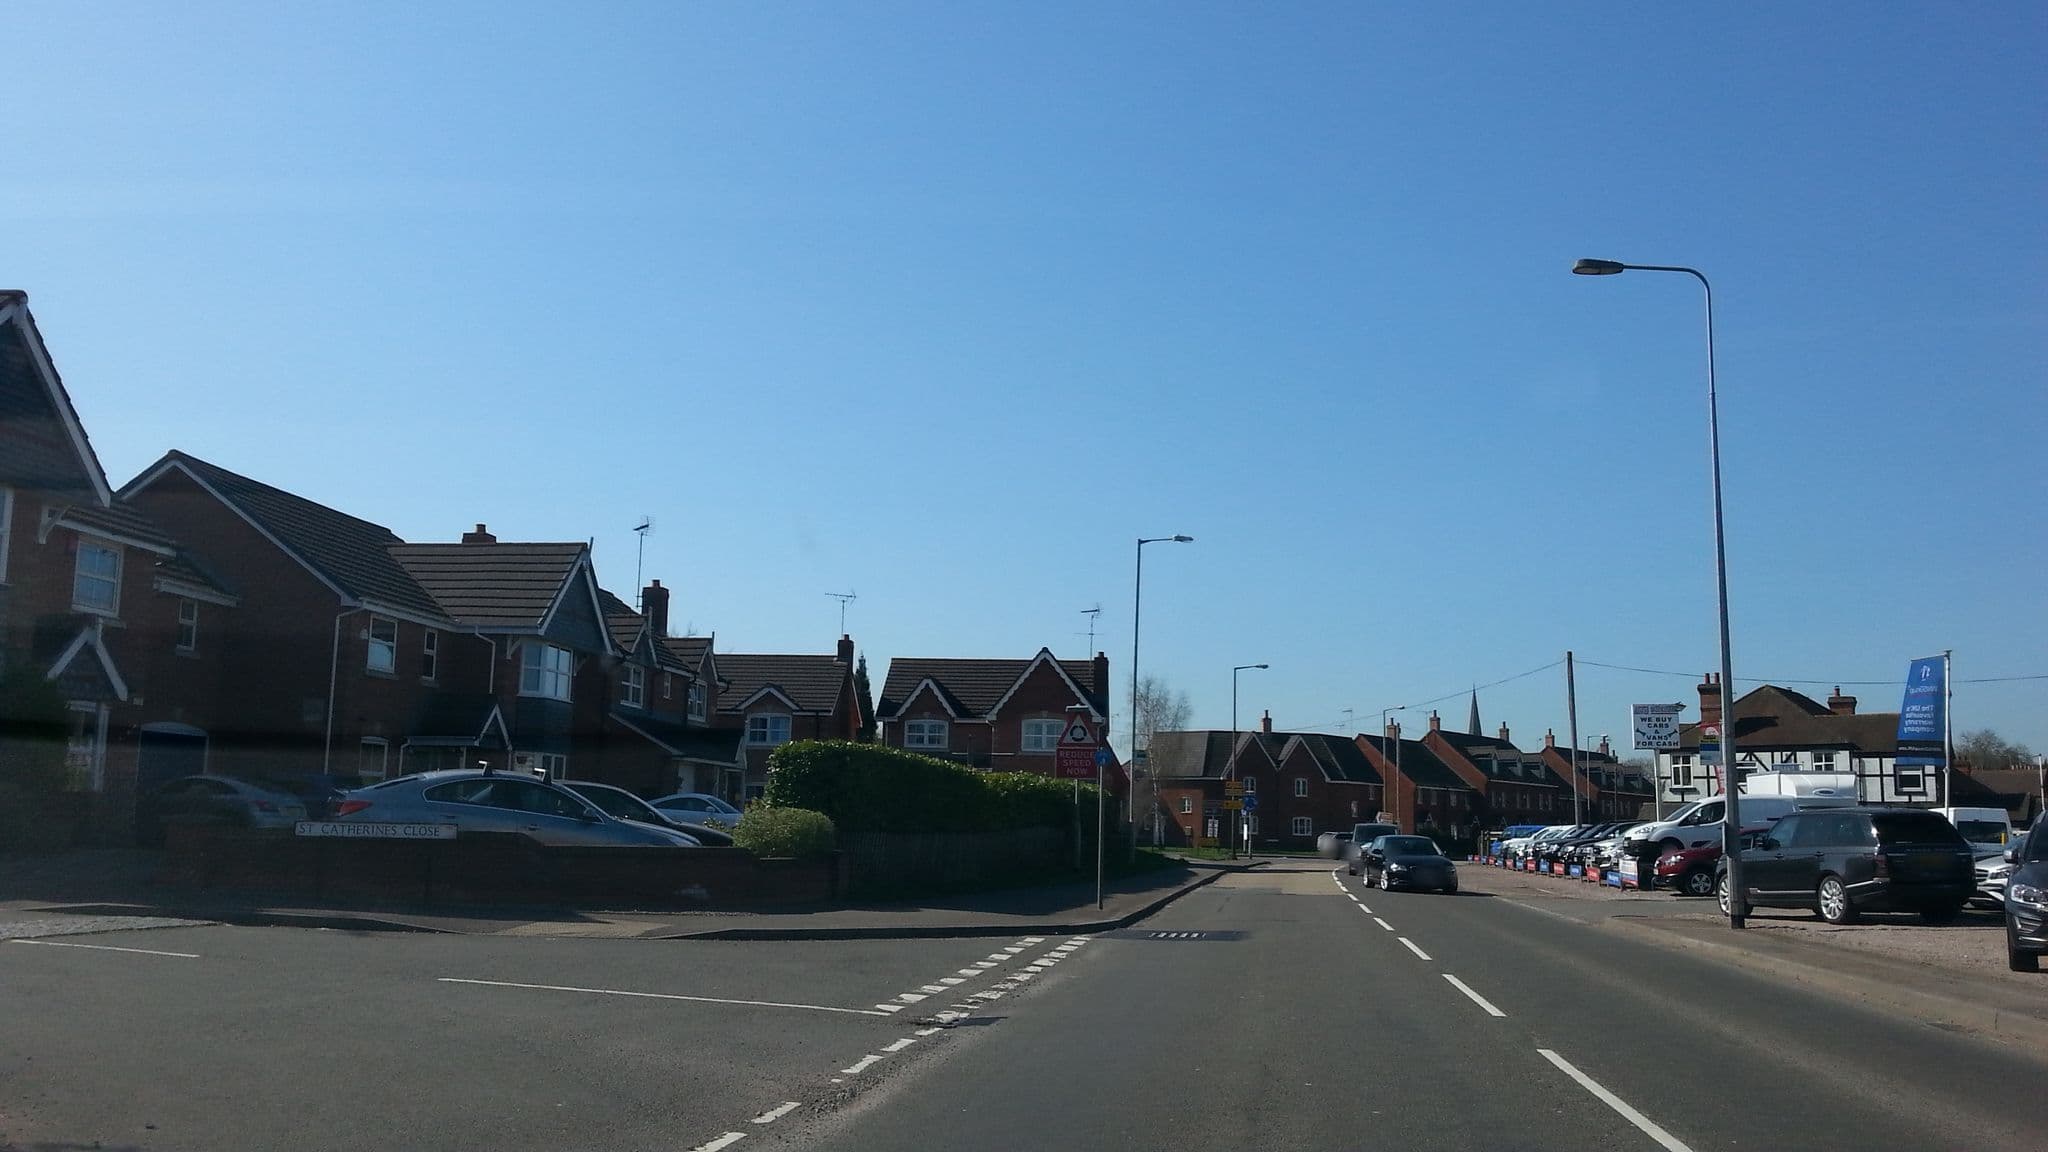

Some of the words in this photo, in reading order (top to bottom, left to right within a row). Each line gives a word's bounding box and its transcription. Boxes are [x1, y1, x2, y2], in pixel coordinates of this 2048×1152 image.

[1060, 751, 1095, 759] REDUCE
[299, 825, 312, 834] ST
[321, 824, 398, 837] CATHERINES
[403, 825, 440, 837] CLOSE
